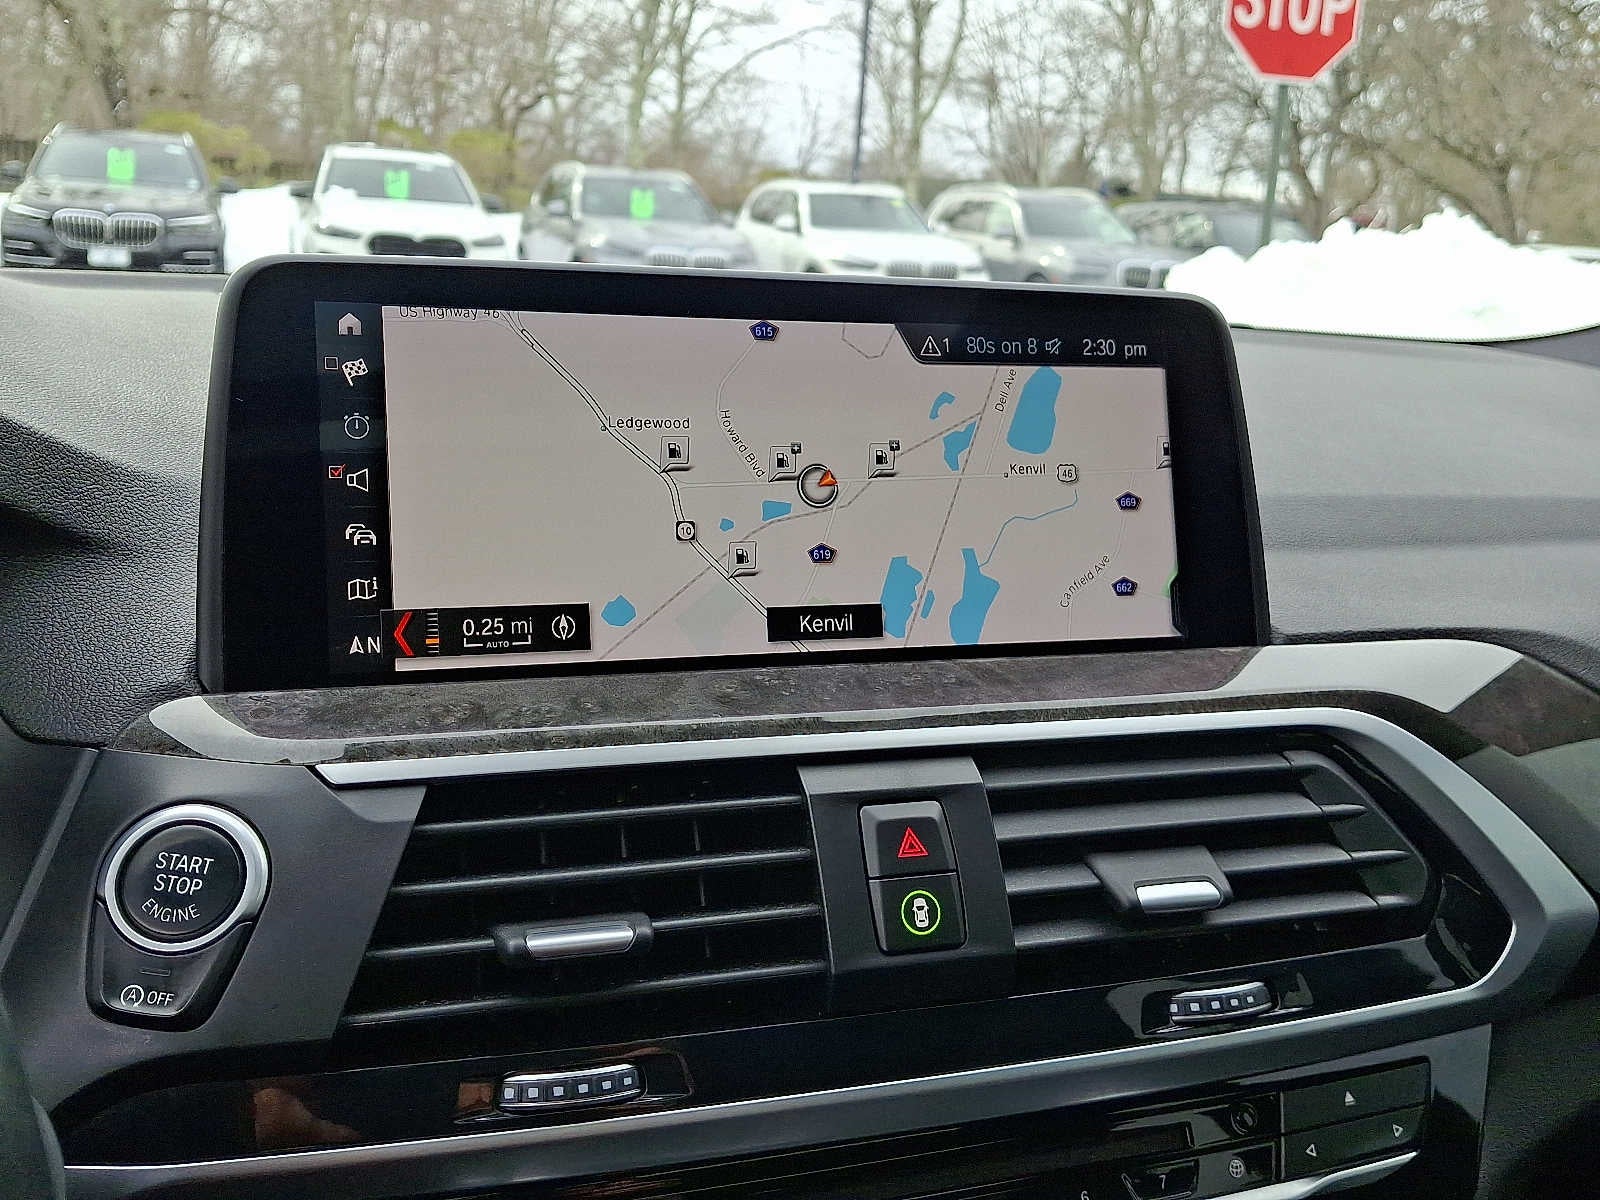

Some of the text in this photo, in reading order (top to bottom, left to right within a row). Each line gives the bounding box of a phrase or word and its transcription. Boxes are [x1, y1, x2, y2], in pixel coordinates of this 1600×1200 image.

[400, 306, 418, 318] US
[755, 326, 773, 337] 615
[966, 337, 1038, 354] 80s on 8
[1083, 339, 1147, 359] 2:30 pm
[994, 368, 1017, 412] Dell Ave
[608, 416, 691, 430] Ledgewood
[720, 409, 766, 479] Howard Blvd
[1009, 463, 1047, 475] Kenvil
[1062, 468, 1073, 478] 46
[1120, 498, 1136, 507] 669
[681, 526, 692, 536] 10
[813, 549, 831, 560] 619
[1060, 554, 1110, 608] Canfield Ave
[1116, 583, 1133, 593] 662
[462, 617, 533, 636] 0.25 mi
[800, 613, 854, 633] Kenvil
[486, 640, 510, 648] AUTO
[155, 852, 214, 874] START
[153, 874, 203, 895] STOP
[141, 898, 201, 923] ENGINE
[146, 991, 175, 1007] OFF
